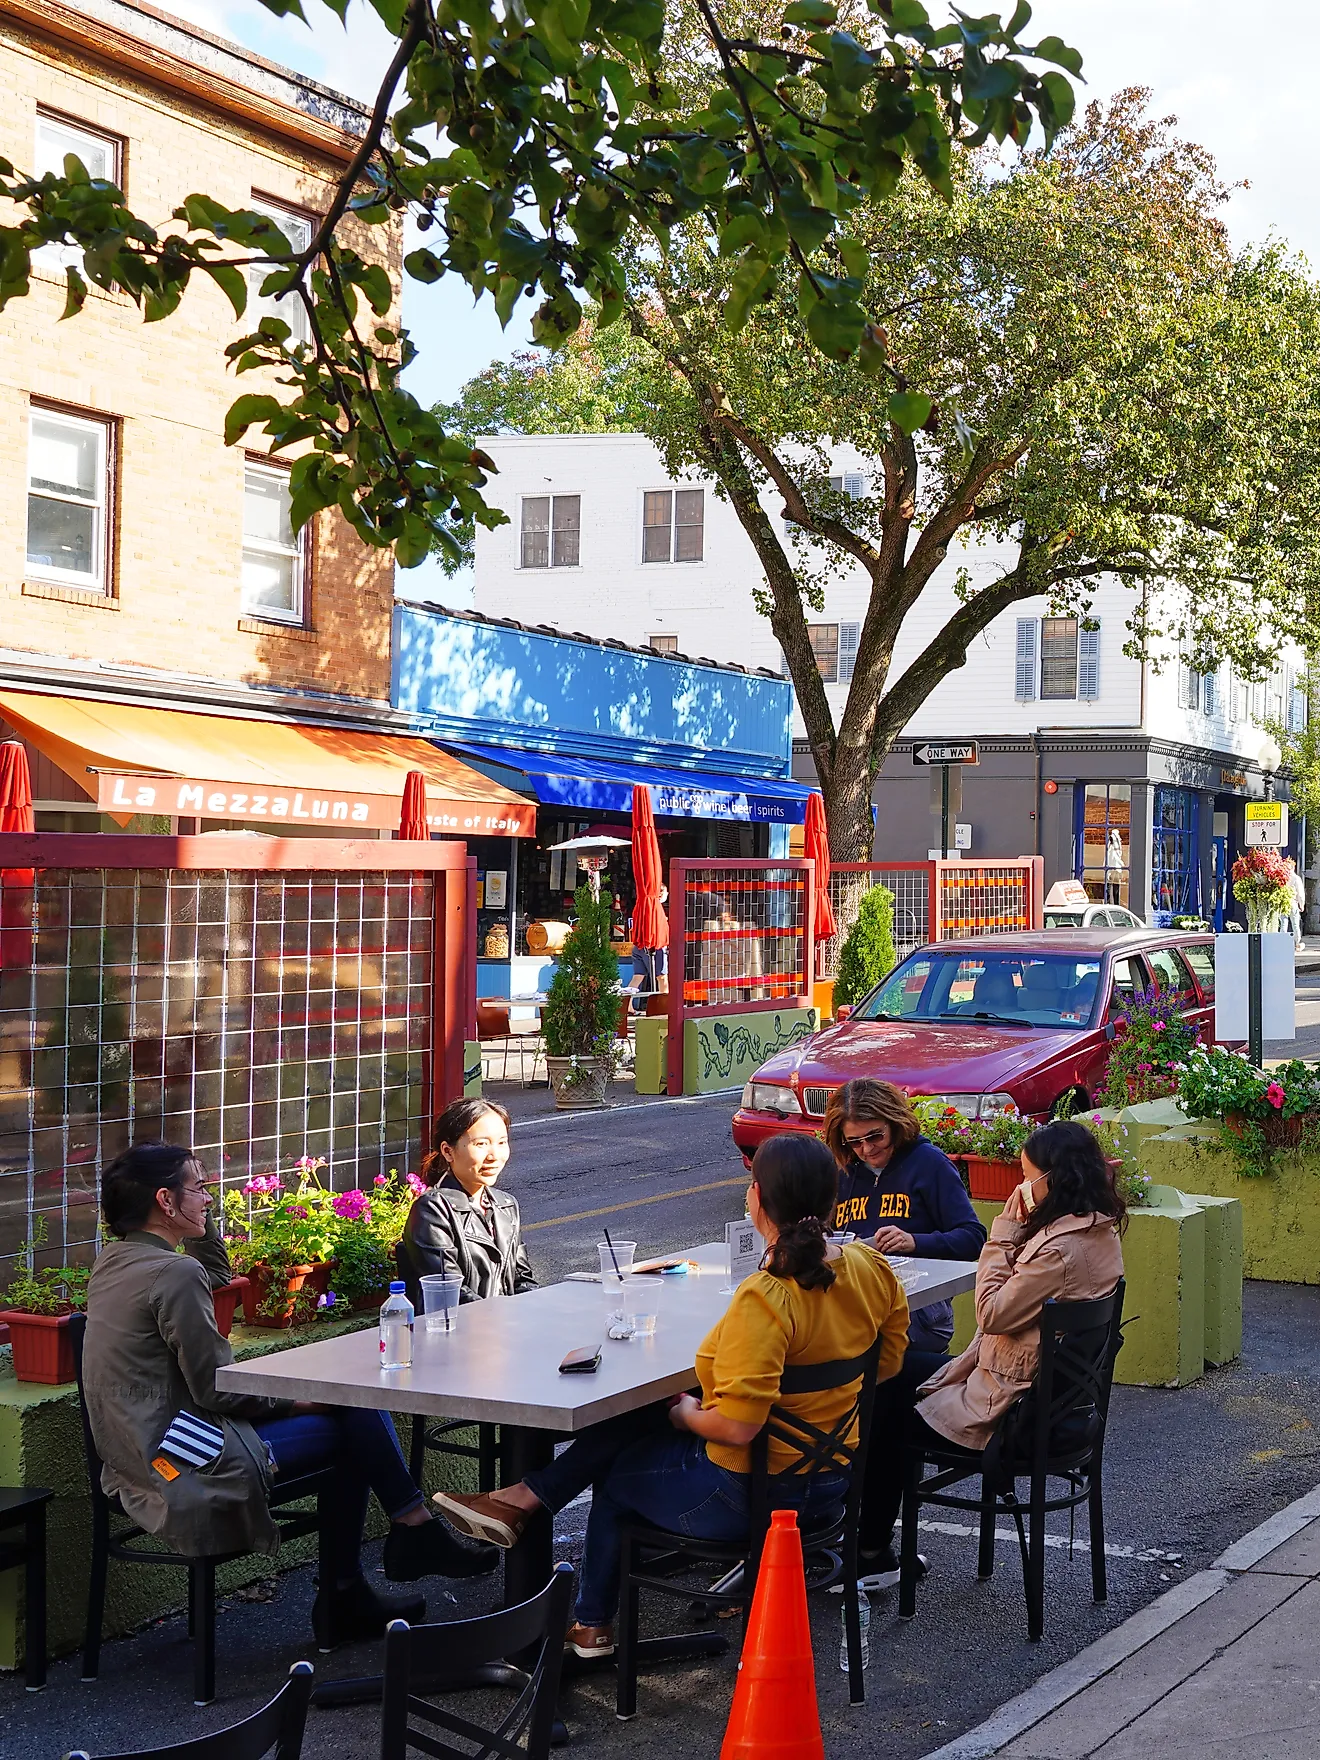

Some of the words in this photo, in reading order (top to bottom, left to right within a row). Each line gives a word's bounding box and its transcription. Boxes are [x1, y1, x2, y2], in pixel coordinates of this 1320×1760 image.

[927, 749, 946, 758] ONE
[950, 748, 970, 758] WAY
[112, 778, 156, 807] La
[176, 784, 369, 822] MezzaLuna
[659, 795, 690, 810] public
[703, 802, 726, 813] wine
[731, 802, 752, 814] beer
[757, 805, 785, 818] spirits
[426, 814, 457, 826] aste
[464, 815, 480, 828] of
[485, 817, 520, 834] Italy
